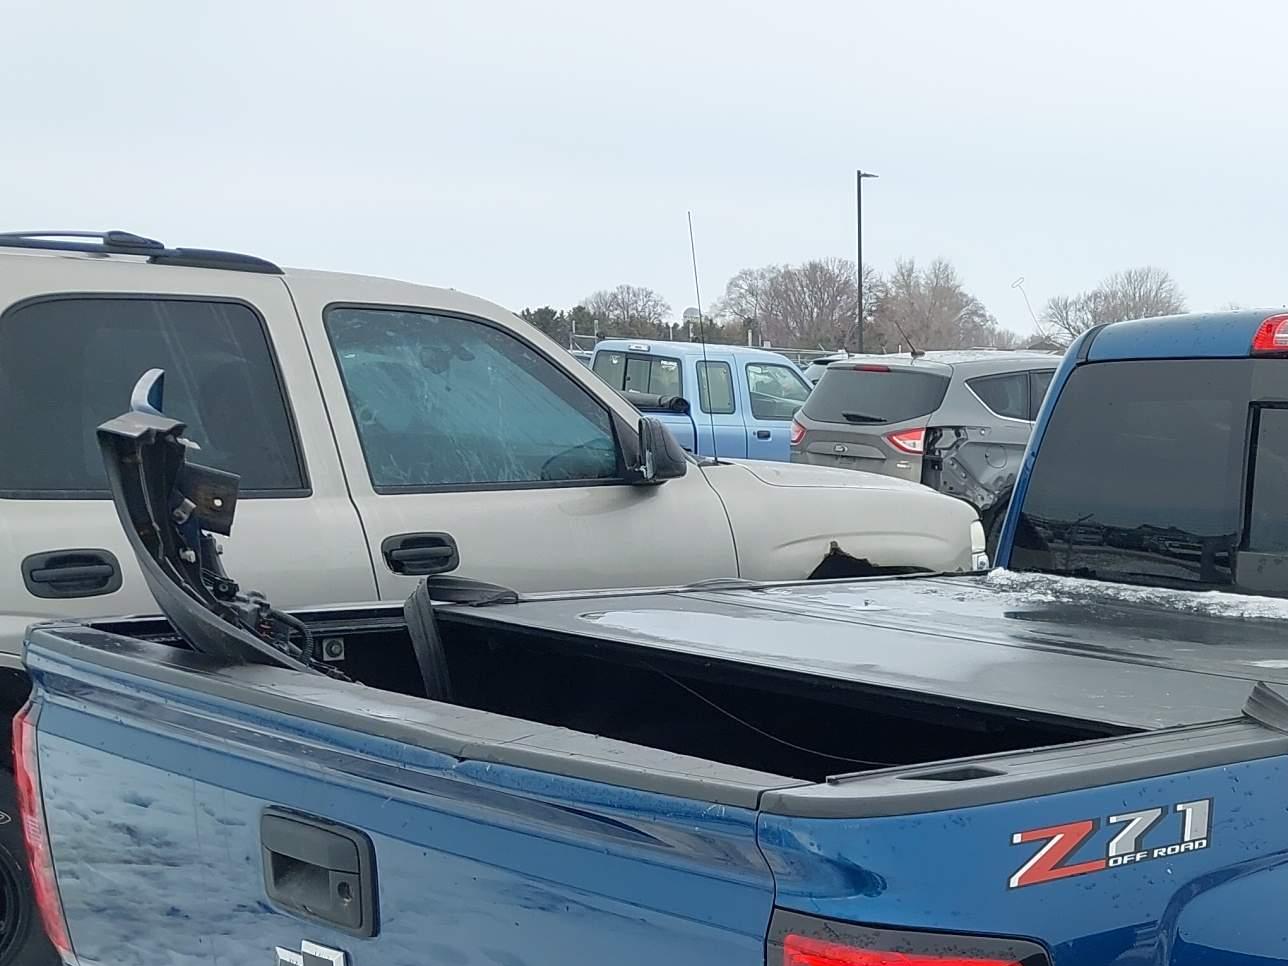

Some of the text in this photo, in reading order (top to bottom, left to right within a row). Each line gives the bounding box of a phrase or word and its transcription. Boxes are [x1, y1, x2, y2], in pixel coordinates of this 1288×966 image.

[1008, 799, 1213, 889] Z71
[1108, 838, 1208, 867] OFF ROAD
